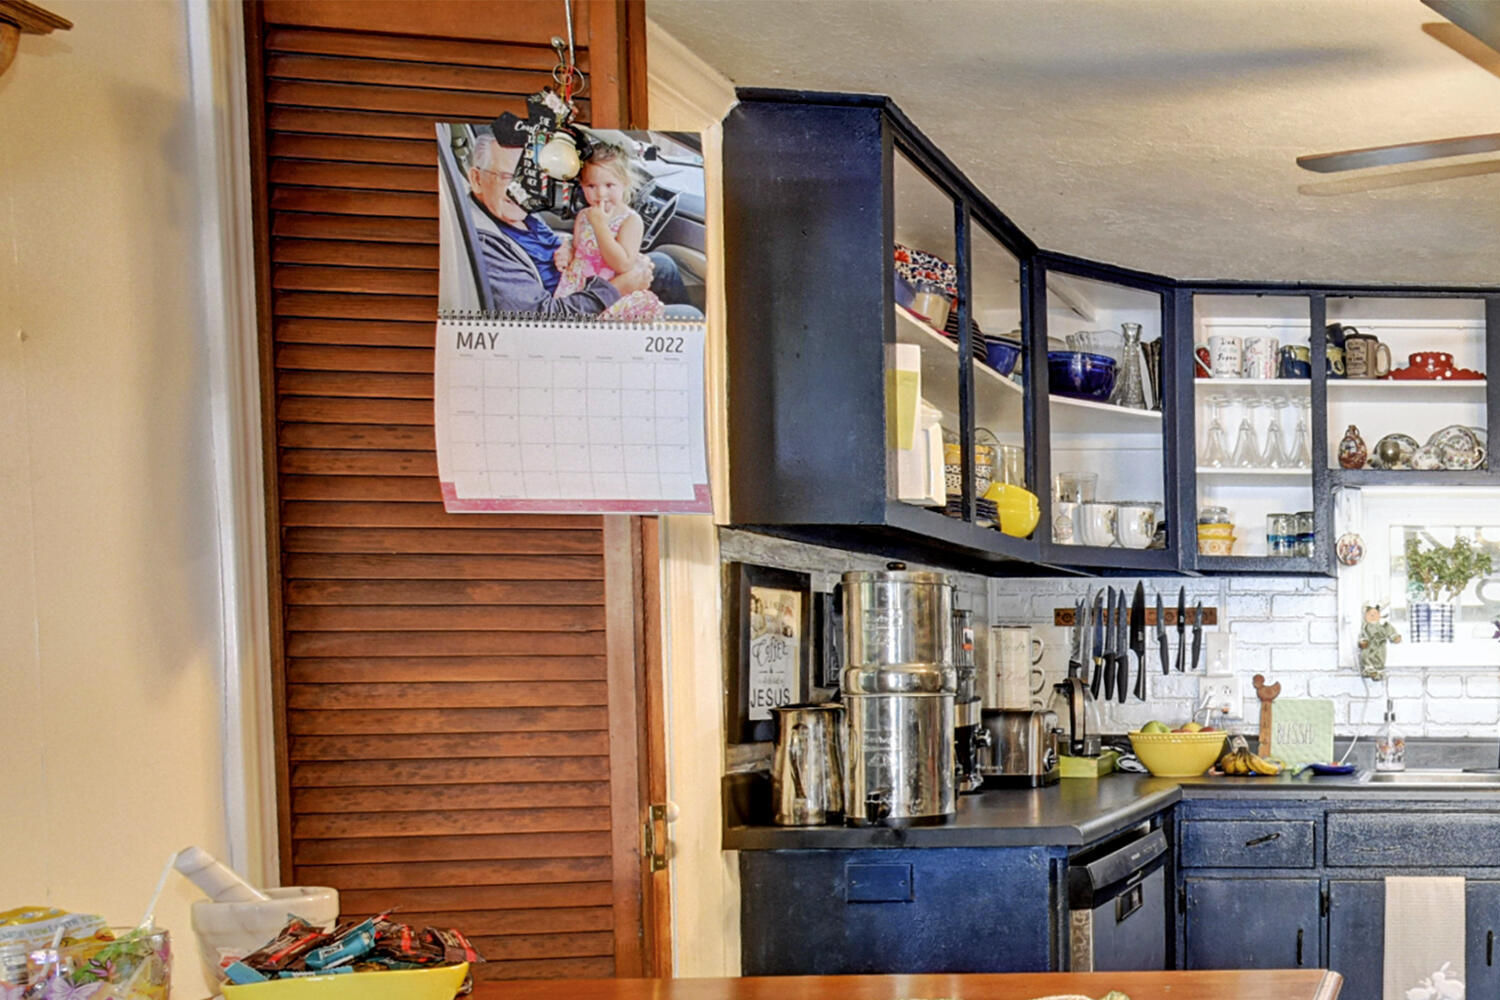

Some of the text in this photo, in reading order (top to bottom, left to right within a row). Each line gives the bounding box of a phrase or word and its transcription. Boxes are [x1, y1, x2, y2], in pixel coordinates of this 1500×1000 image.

[457, 332, 684, 353] MAY 2022
[751, 688, 791, 708] JESUS
